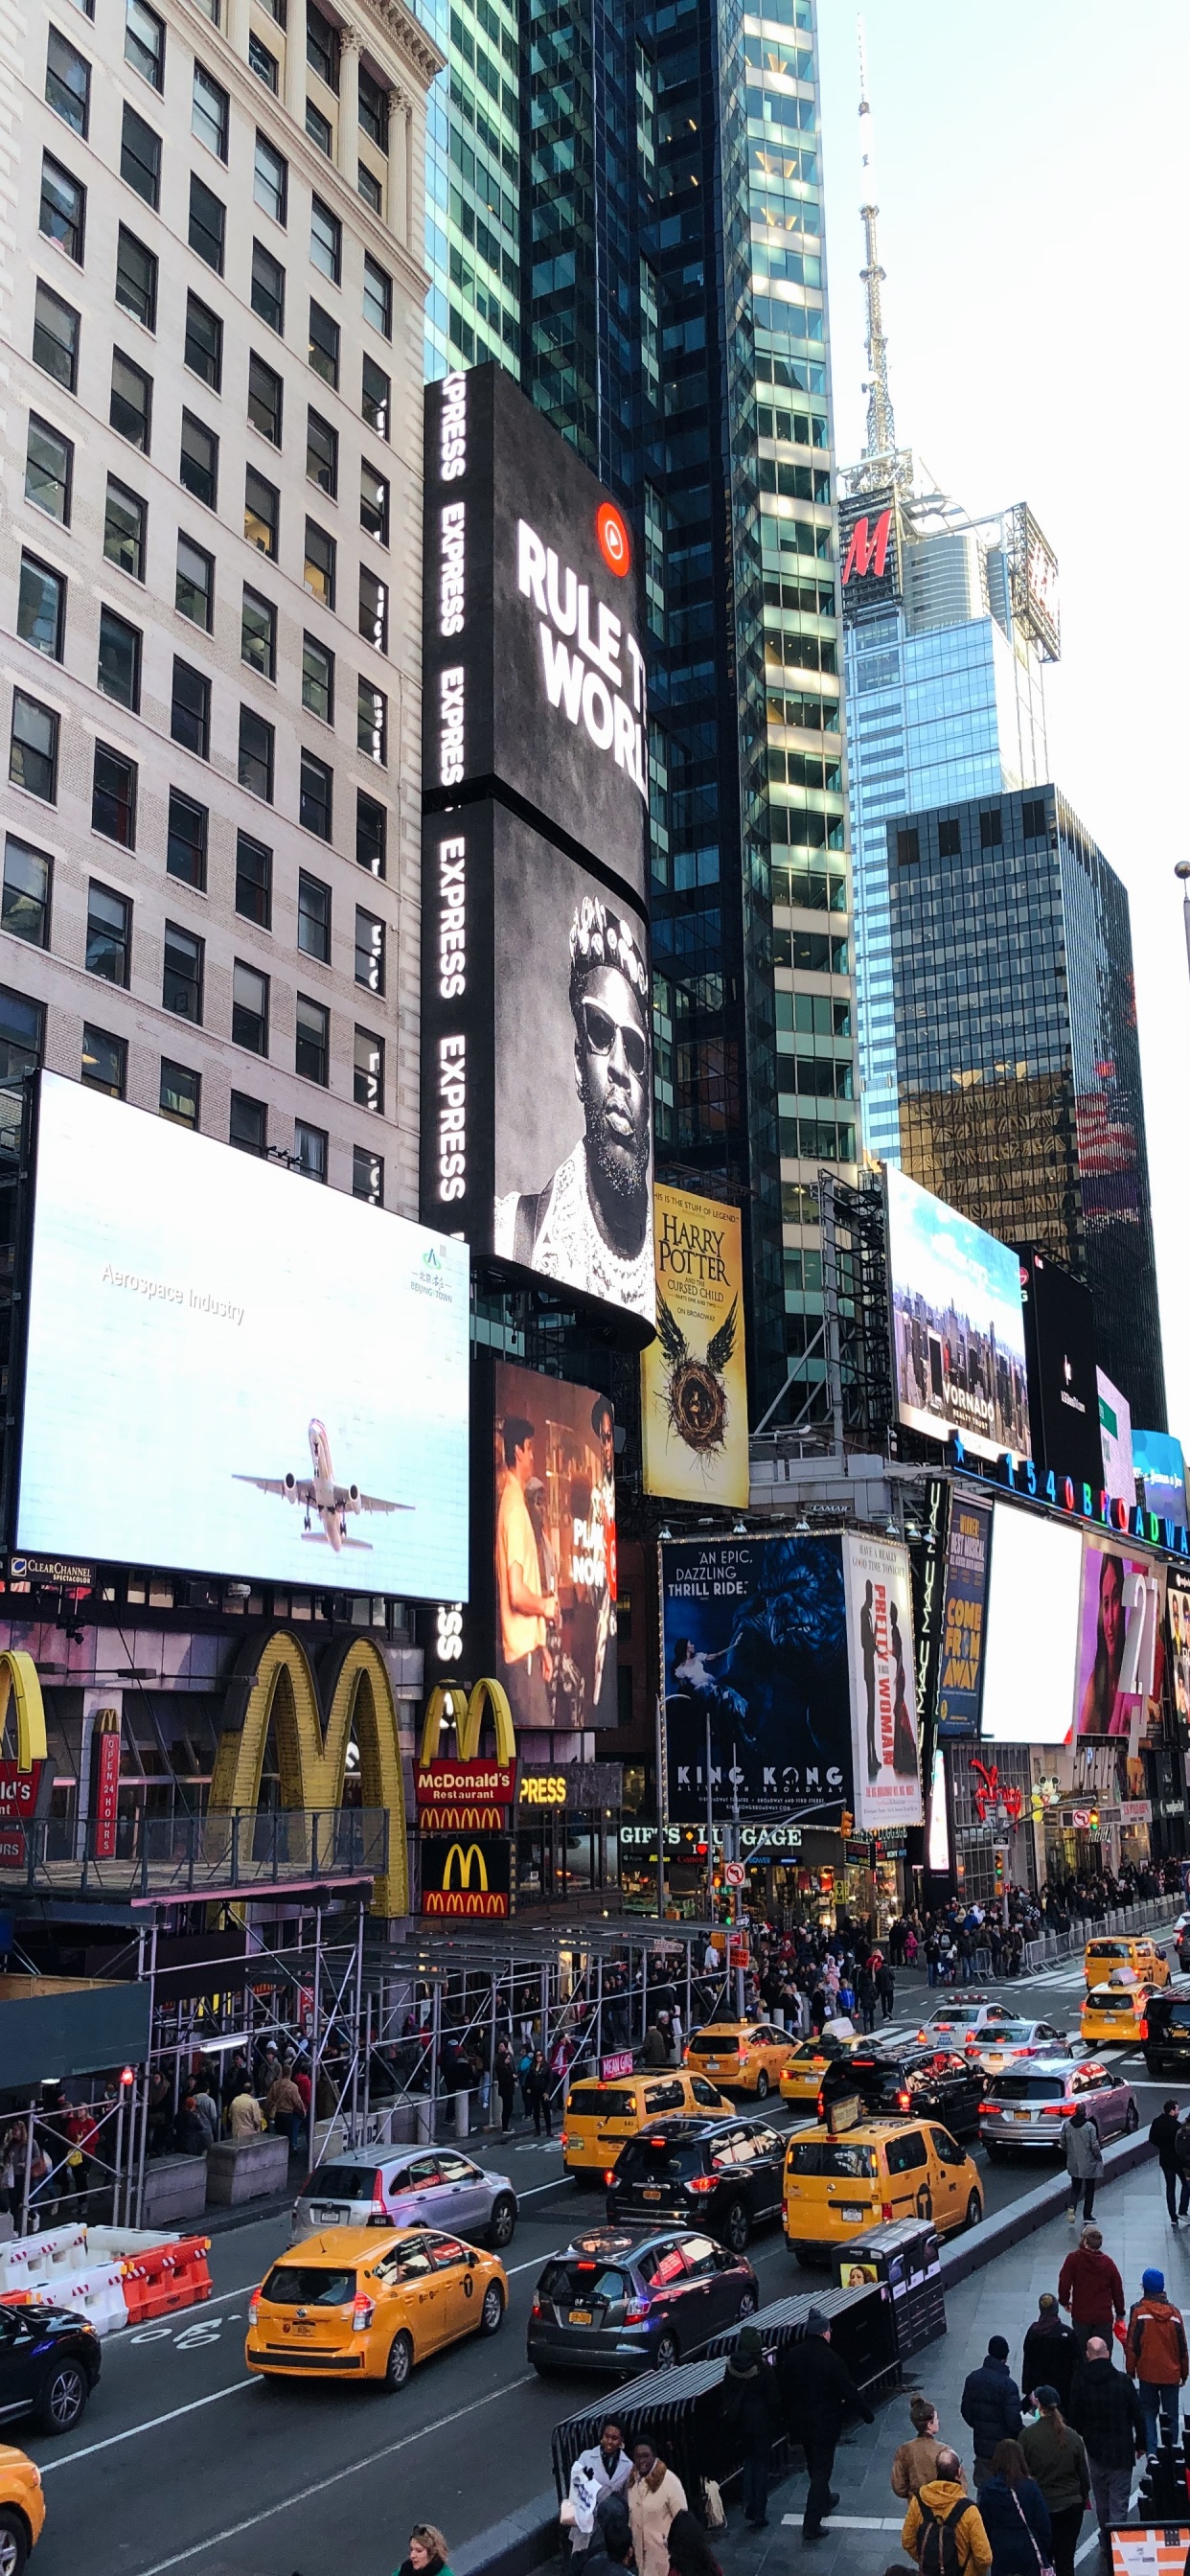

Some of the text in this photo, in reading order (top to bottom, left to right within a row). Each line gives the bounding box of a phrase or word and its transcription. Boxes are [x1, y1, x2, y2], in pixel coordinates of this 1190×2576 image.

[441, 501, 466, 637] EXPRESS
[517, 518, 622, 688] RULE
[439, 836, 466, 1000] EXPRESS
[439, 1034, 466, 1202] EXPRESS
[672, 1196, 683, 1208] THE
[684, 1201, 702, 1212] STUFF
[661, 1212, 725, 1258] HARRY
[658, 1239, 731, 1287] POTTER
[103, 1263, 245, 1326] Aerospace Industry
[667, 1278, 724, 1303] CURSED CHILD
[685, 1276, 705, 1288] AND THE
[676, 1306, 716, 1322] ON BROADWAY
[942, 1380, 995, 1422] VORNADO
[952, 1408, 989, 1431] REALTY TRUST
[1006, 1453, 1075, 1510] 1540
[573, 1518, 605, 1551] PLAY
[721, 1549, 753, 1564] EPIC,
[852, 1557, 867, 1569] GOOD
[868, 1560, 881, 1573] TIME
[858, 1544, 872, 1557] HAVE
[53, 1574, 91, 1584] SPECTACOLOR
[572, 1554, 606, 1588] NOW
[675, 1565, 737, 1581] DAZZLING
[668, 1582, 710, 1598] THRILL
[874, 1583, 889, 1663] PRETTY
[947, 1597, 982, 1632] COME
[1124, 1573, 1158, 1696] 21
[943, 1657, 979, 1690] AWAY
[878, 1677, 894, 1768] WOMAN
[106, 1739, 115, 1781] OPEN
[103, 1784, 114, 1794] 24
[418, 1773, 510, 1788] McDonald's
[676, 1765, 844, 1786] KING KONG
[763, 1785, 844, 1794] BROADWAY
[432, 1789, 494, 1800] Restaurant
[676, 1855, 705, 1865] Canon
